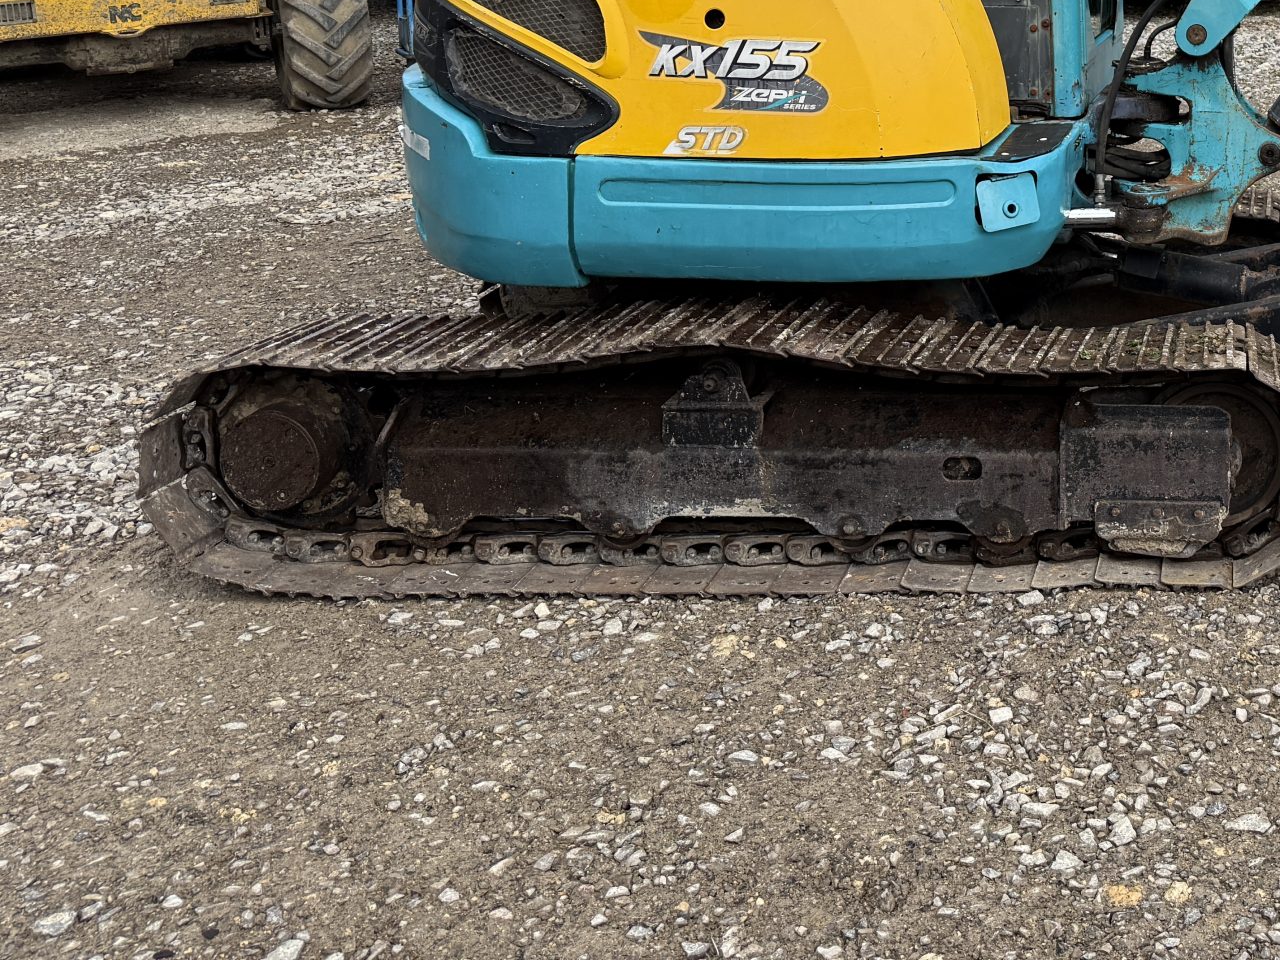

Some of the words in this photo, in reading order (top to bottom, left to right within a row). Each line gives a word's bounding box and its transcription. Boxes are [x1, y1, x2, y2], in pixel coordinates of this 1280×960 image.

[649, 40, 821, 81] KX155
[783, 103, 817, 111] SERIES
[678, 126, 744, 150] STD
